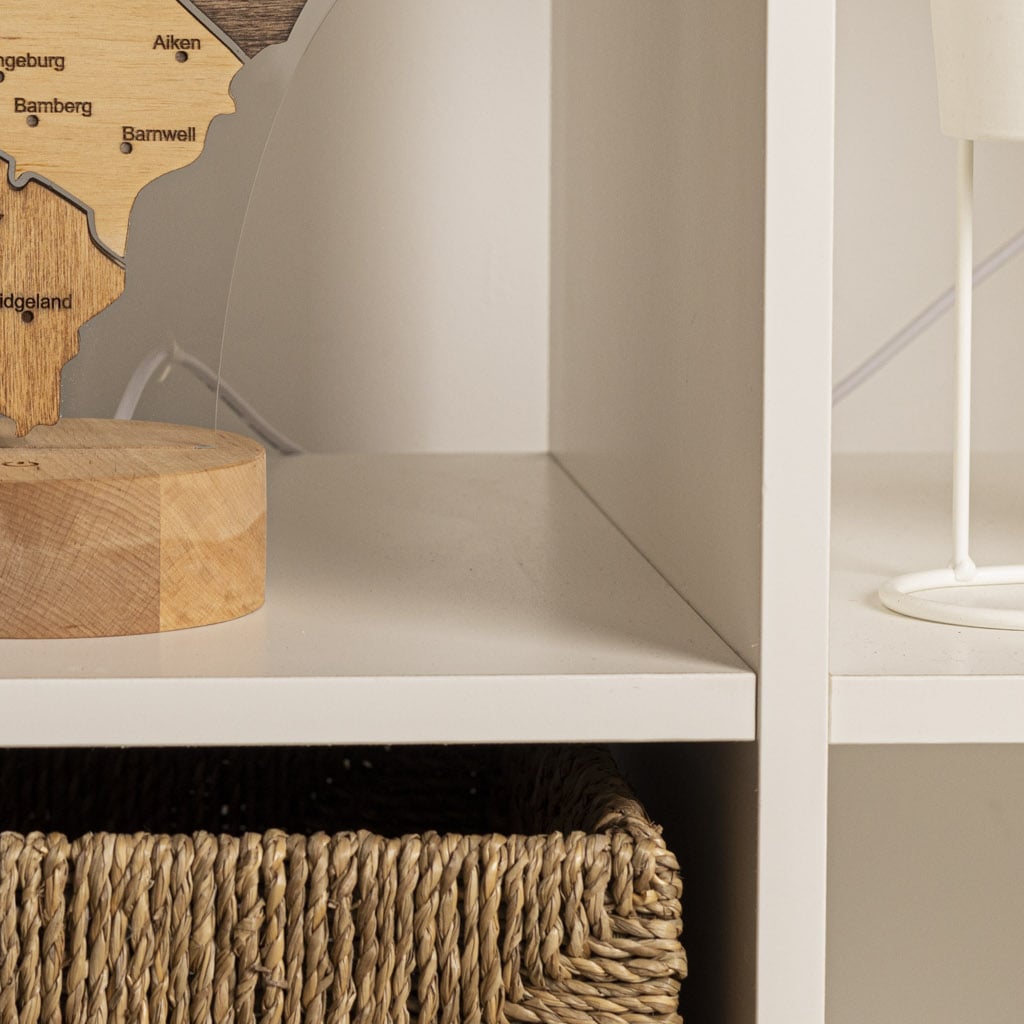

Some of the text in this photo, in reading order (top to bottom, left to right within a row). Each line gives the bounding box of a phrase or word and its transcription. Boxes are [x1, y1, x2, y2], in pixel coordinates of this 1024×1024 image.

[152, 35, 201, 50] Aiken
[14, 97, 93, 117] Bamberg
[122, 126, 196, 142] Barnwell
